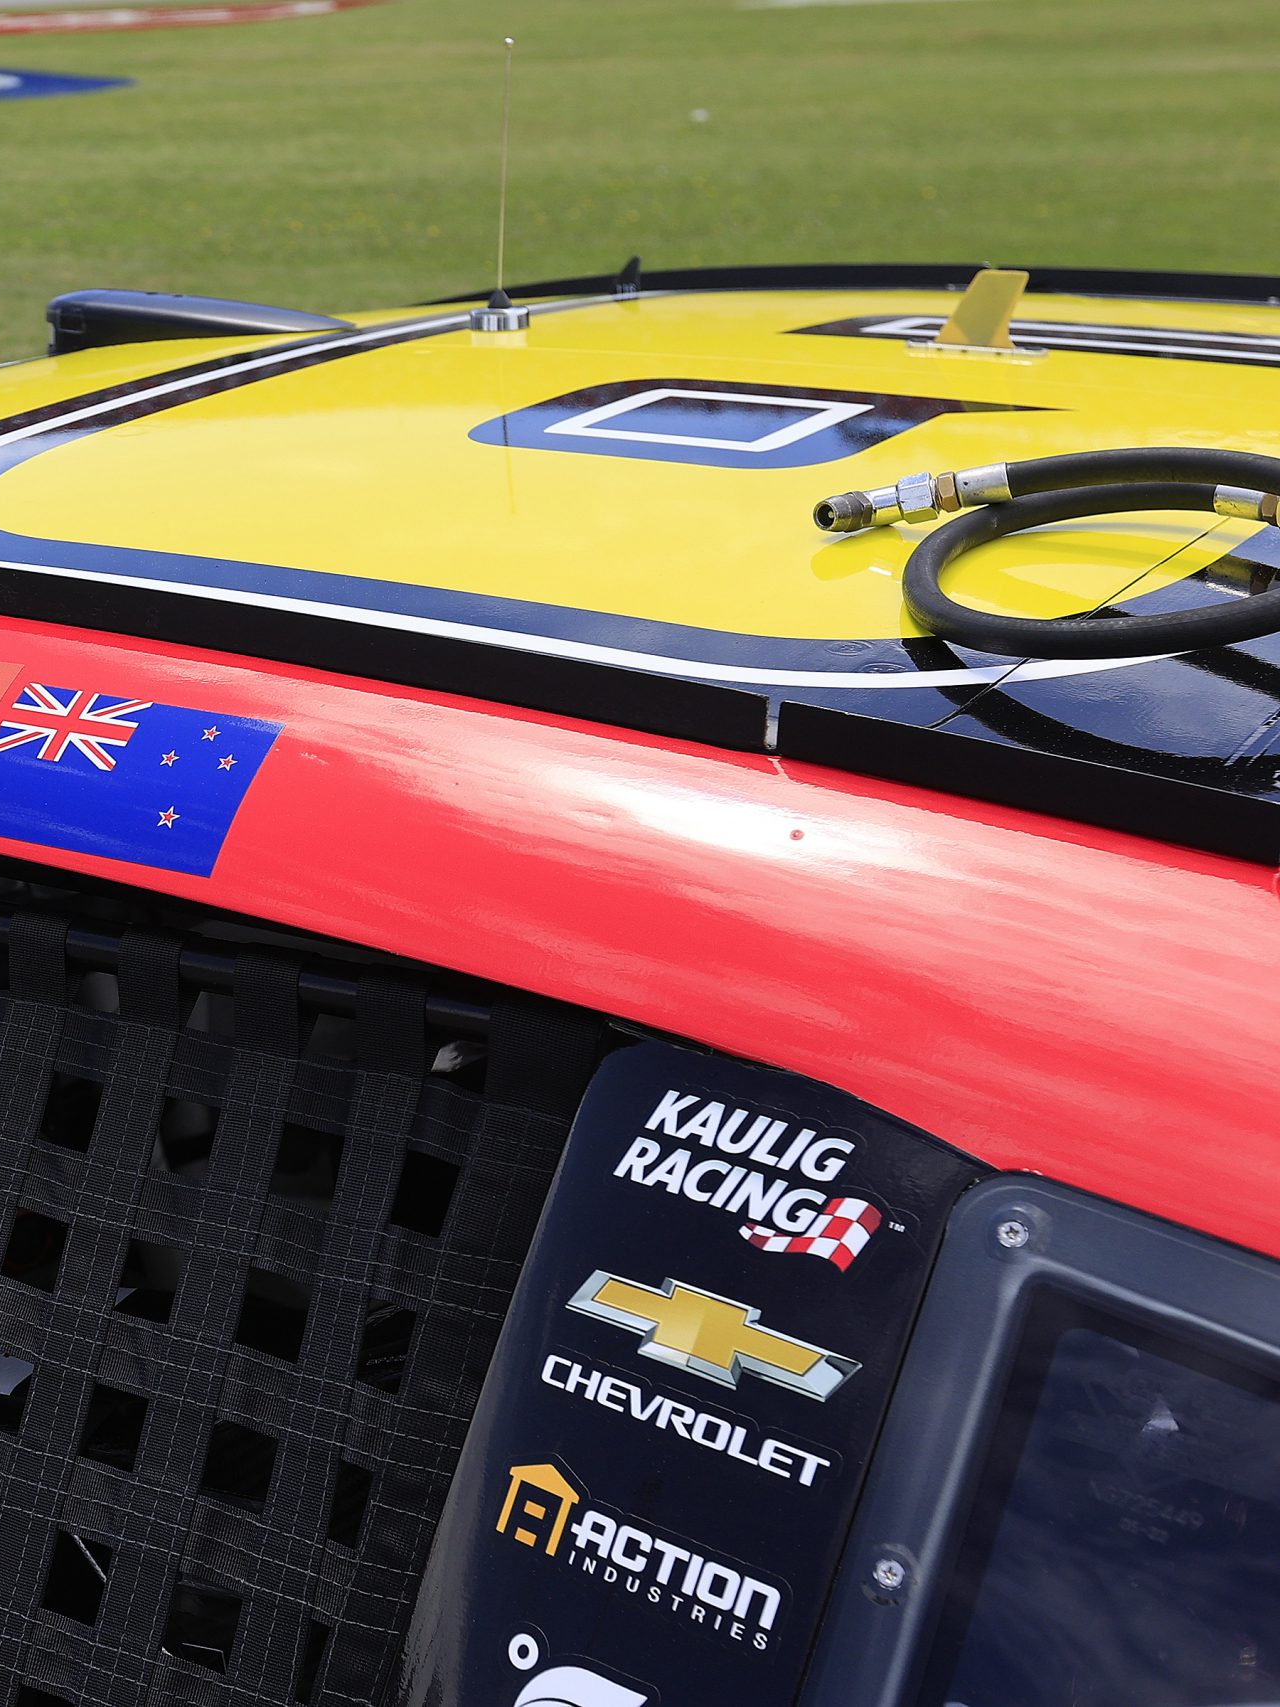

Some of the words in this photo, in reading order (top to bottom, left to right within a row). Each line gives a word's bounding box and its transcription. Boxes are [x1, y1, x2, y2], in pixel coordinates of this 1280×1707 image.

[644, 1089, 856, 1182] KAULIG
[612, 1136, 828, 1236] RACING
[541, 1354, 831, 1487] CHEVROLET
[568, 1550, 768, 1650] INDUSTRIES
[570, 1510, 781, 1631] ACTION
